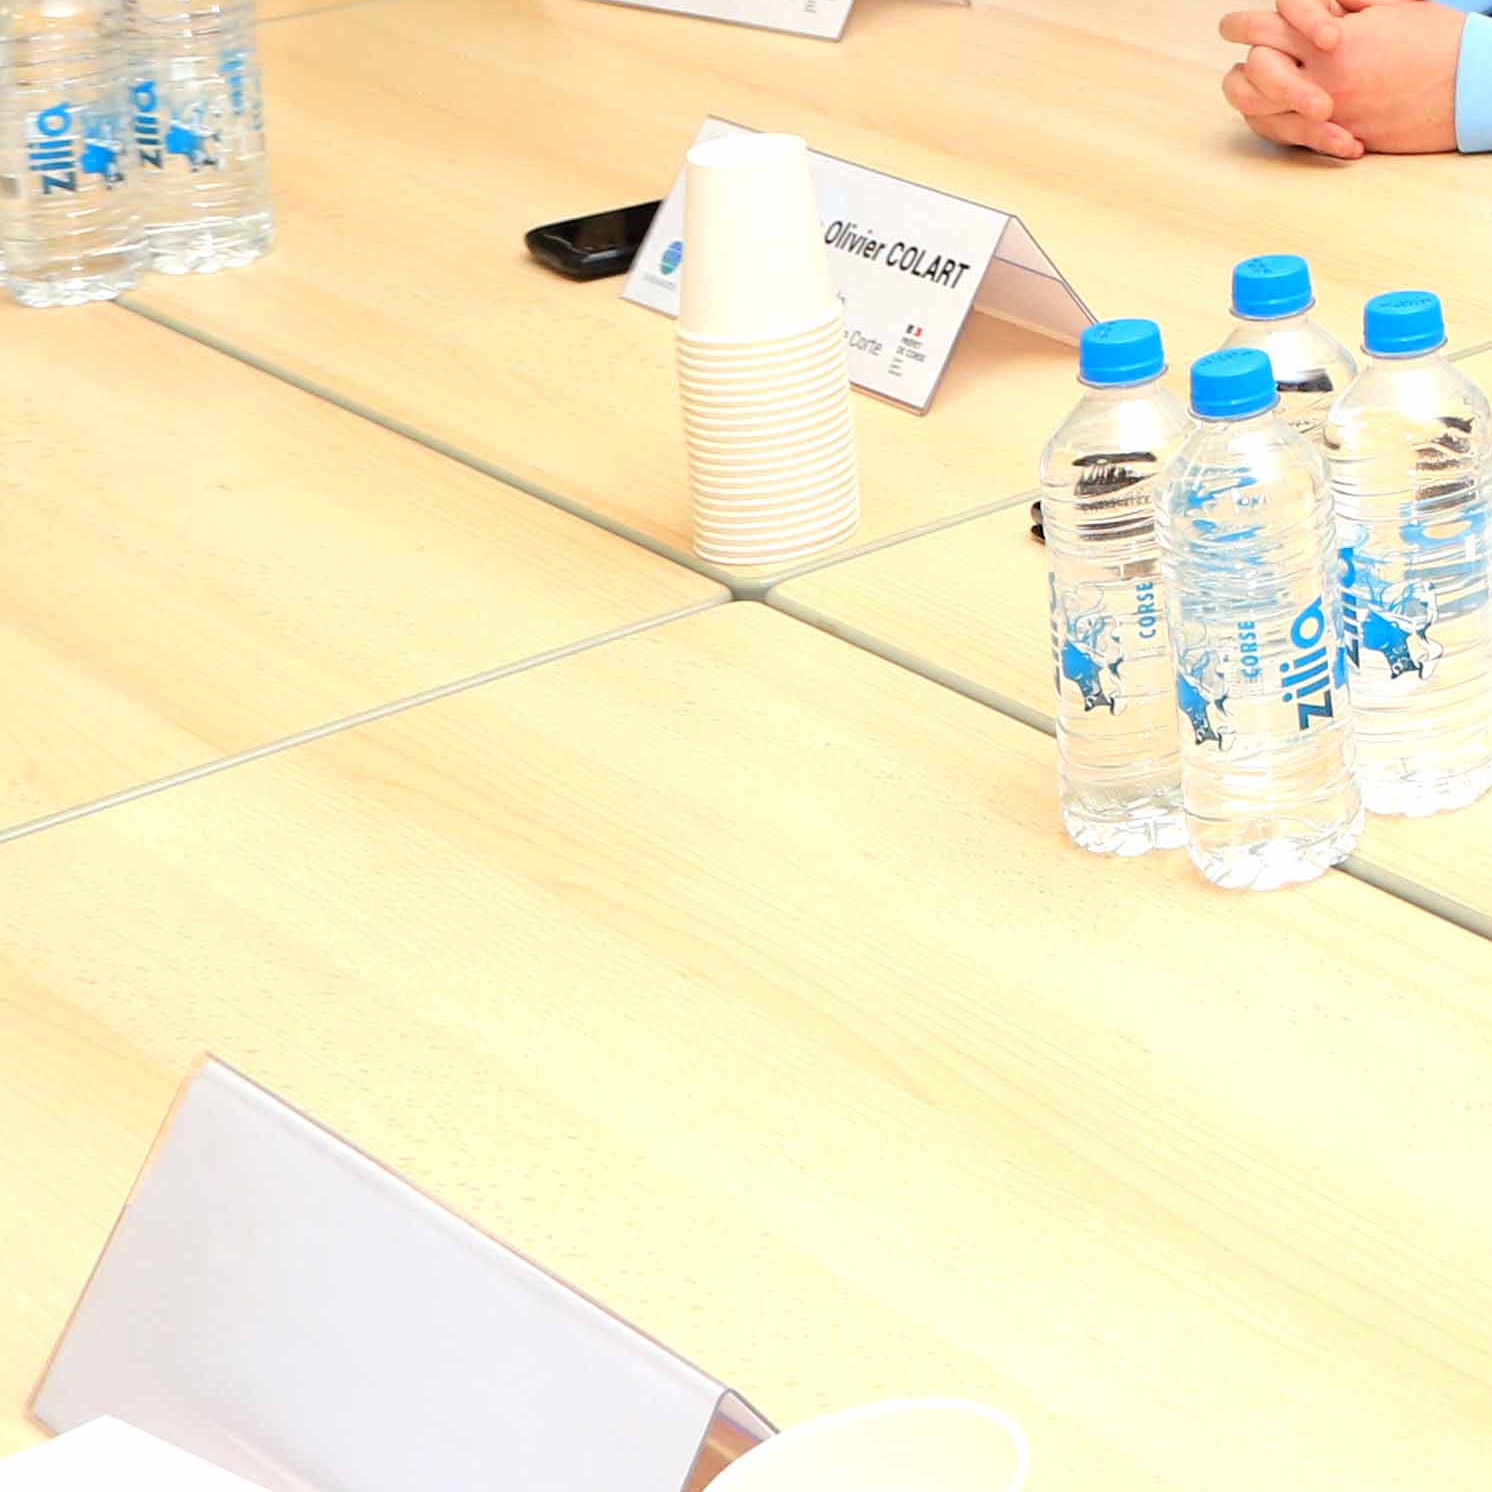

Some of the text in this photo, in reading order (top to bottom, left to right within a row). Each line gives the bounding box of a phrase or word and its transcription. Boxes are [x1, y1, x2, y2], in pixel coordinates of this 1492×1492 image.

[823, 220, 971, 289] Olivier COLART
[849, 329, 883, 357] Corte
[1136, 582, 1157, 640] CORSE
[1238, 620, 1260, 680] CORSE
[1280, 596, 1334, 731] zilia
